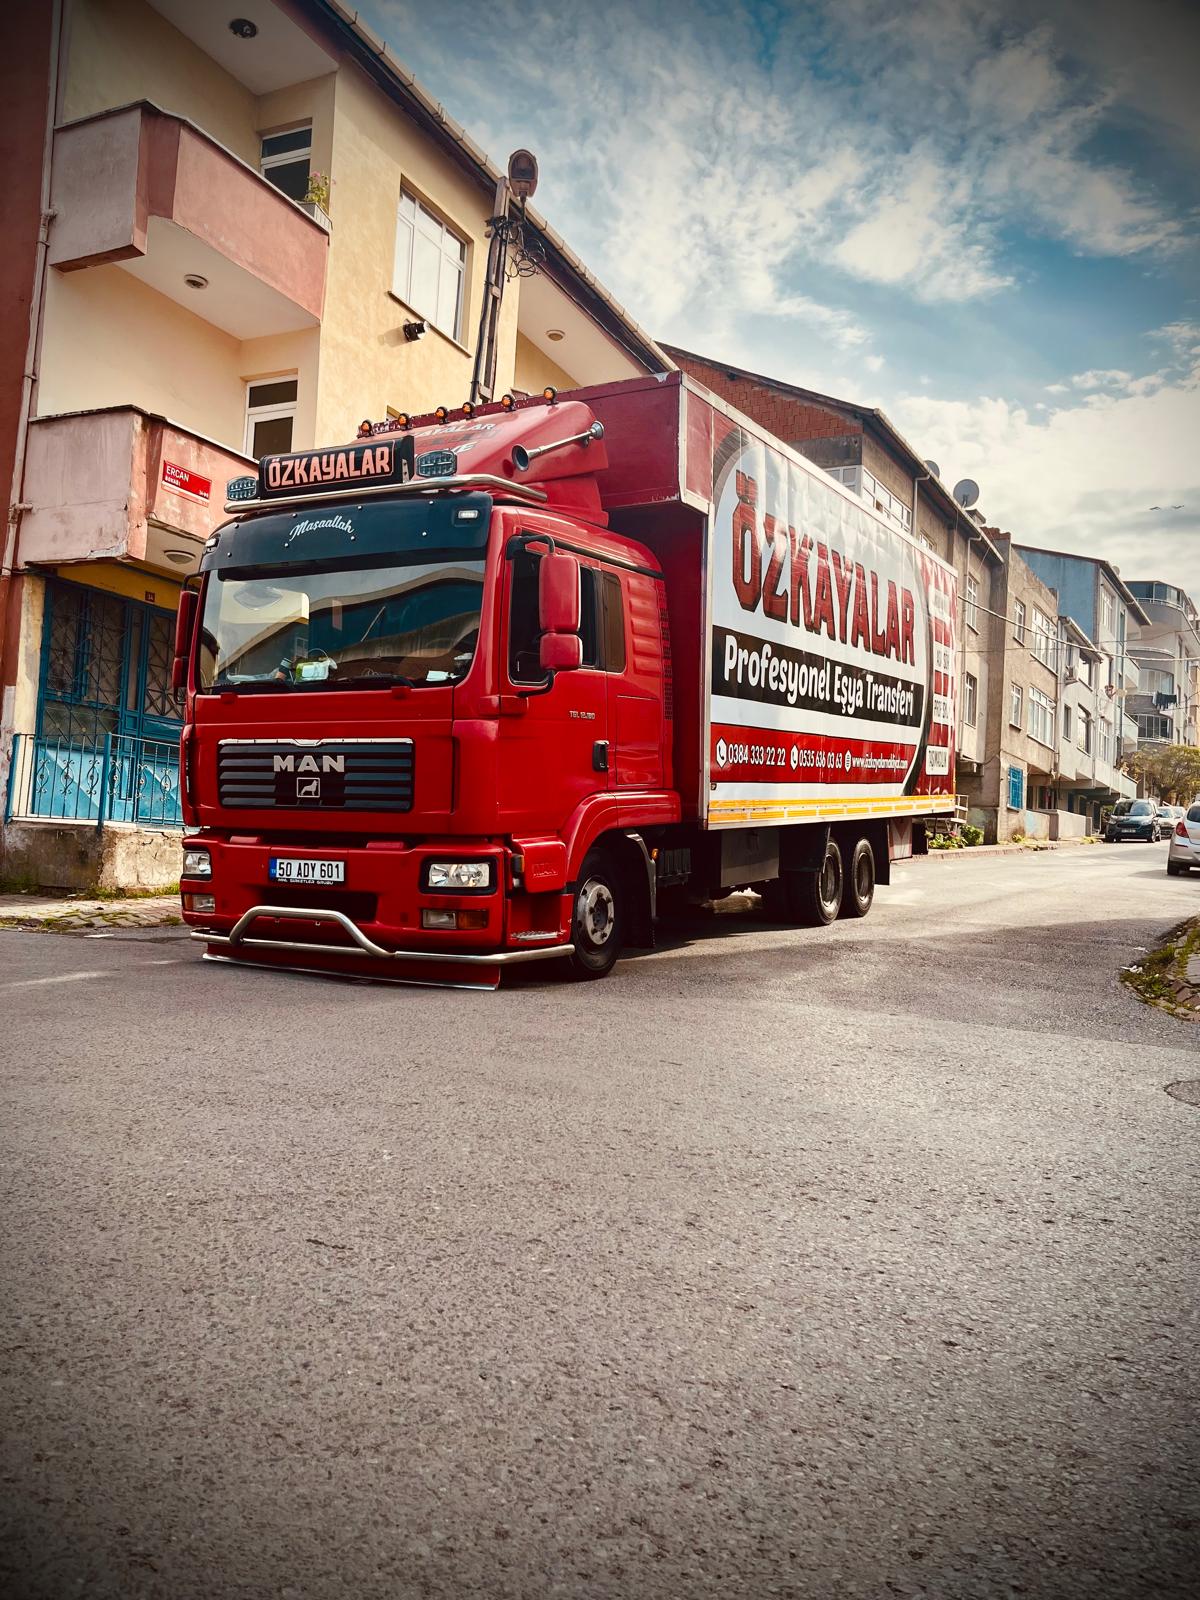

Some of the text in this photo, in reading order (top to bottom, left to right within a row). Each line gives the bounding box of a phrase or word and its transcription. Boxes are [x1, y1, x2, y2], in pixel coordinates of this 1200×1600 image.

[166, 465, 190, 482] ERCAN
[268, 446, 390, 488] ÖZKAYALAR
[732, 469, 915, 667] ÖZKAYALAR
[724, 634, 914, 717] Profesyonel Eşya Transferi
[273, 755, 345, 773] MAN
[728, 743, 786, 766] 0384 333 22 22
[799, 749, 815, 767] 0535
[827, 752, 834, 769] 03
[836, 752, 843, 769] 63
[278, 862, 340, 879] 50 ADY 601
